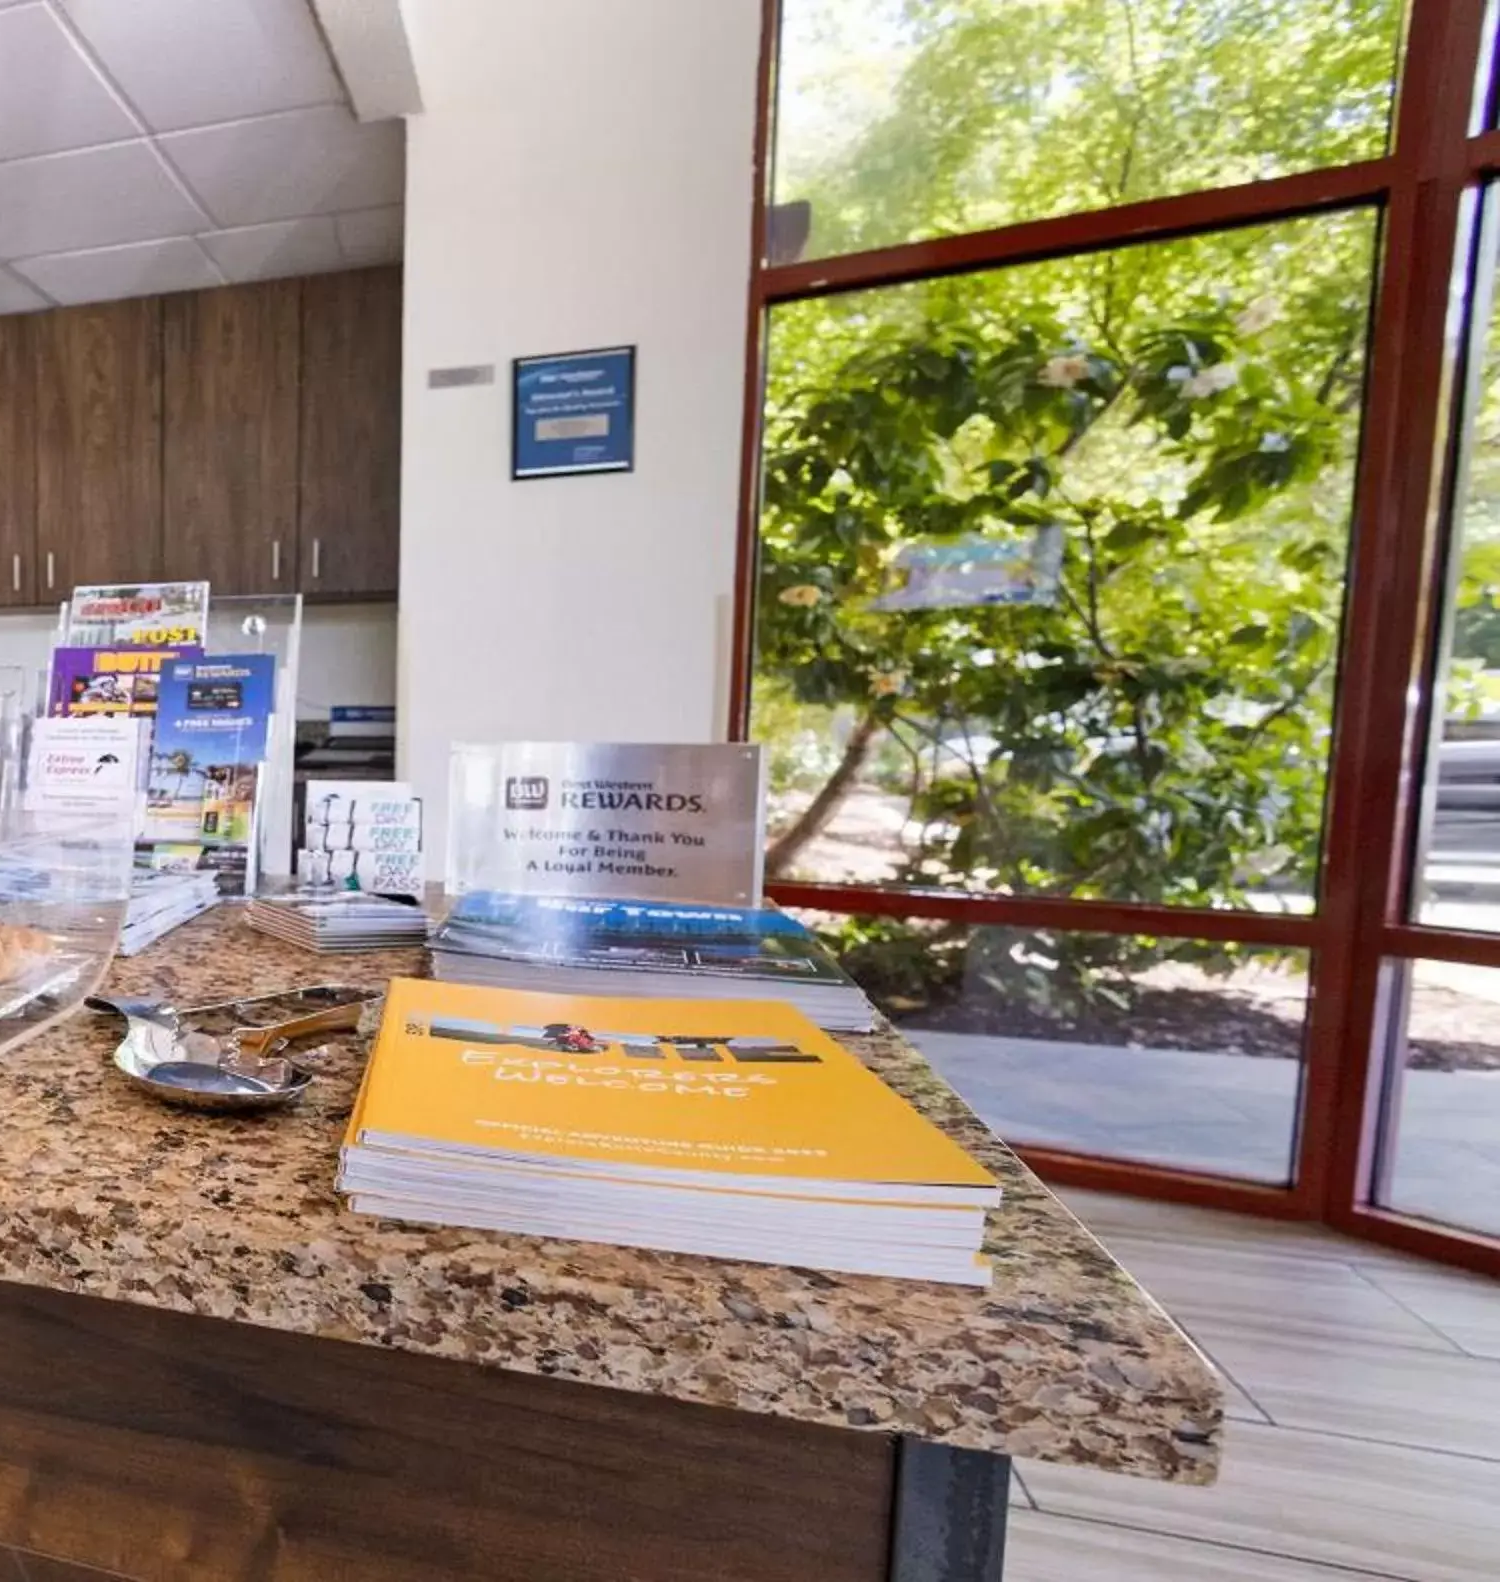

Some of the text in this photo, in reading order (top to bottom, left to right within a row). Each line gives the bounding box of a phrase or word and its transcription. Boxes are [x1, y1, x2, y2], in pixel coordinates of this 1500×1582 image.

[370, 801, 413, 813] FREE
[369, 826, 413, 840] FREE
[502, 828, 706, 847] Welcome & Thank You
[374, 853, 420, 867] FREE
[558, 845, 647, 862] For Being
[378, 865, 414, 877] DAY
[526, 860, 539, 872] A
[544, 860, 592, 875] Loyal
[373, 877, 421, 891] PASS
